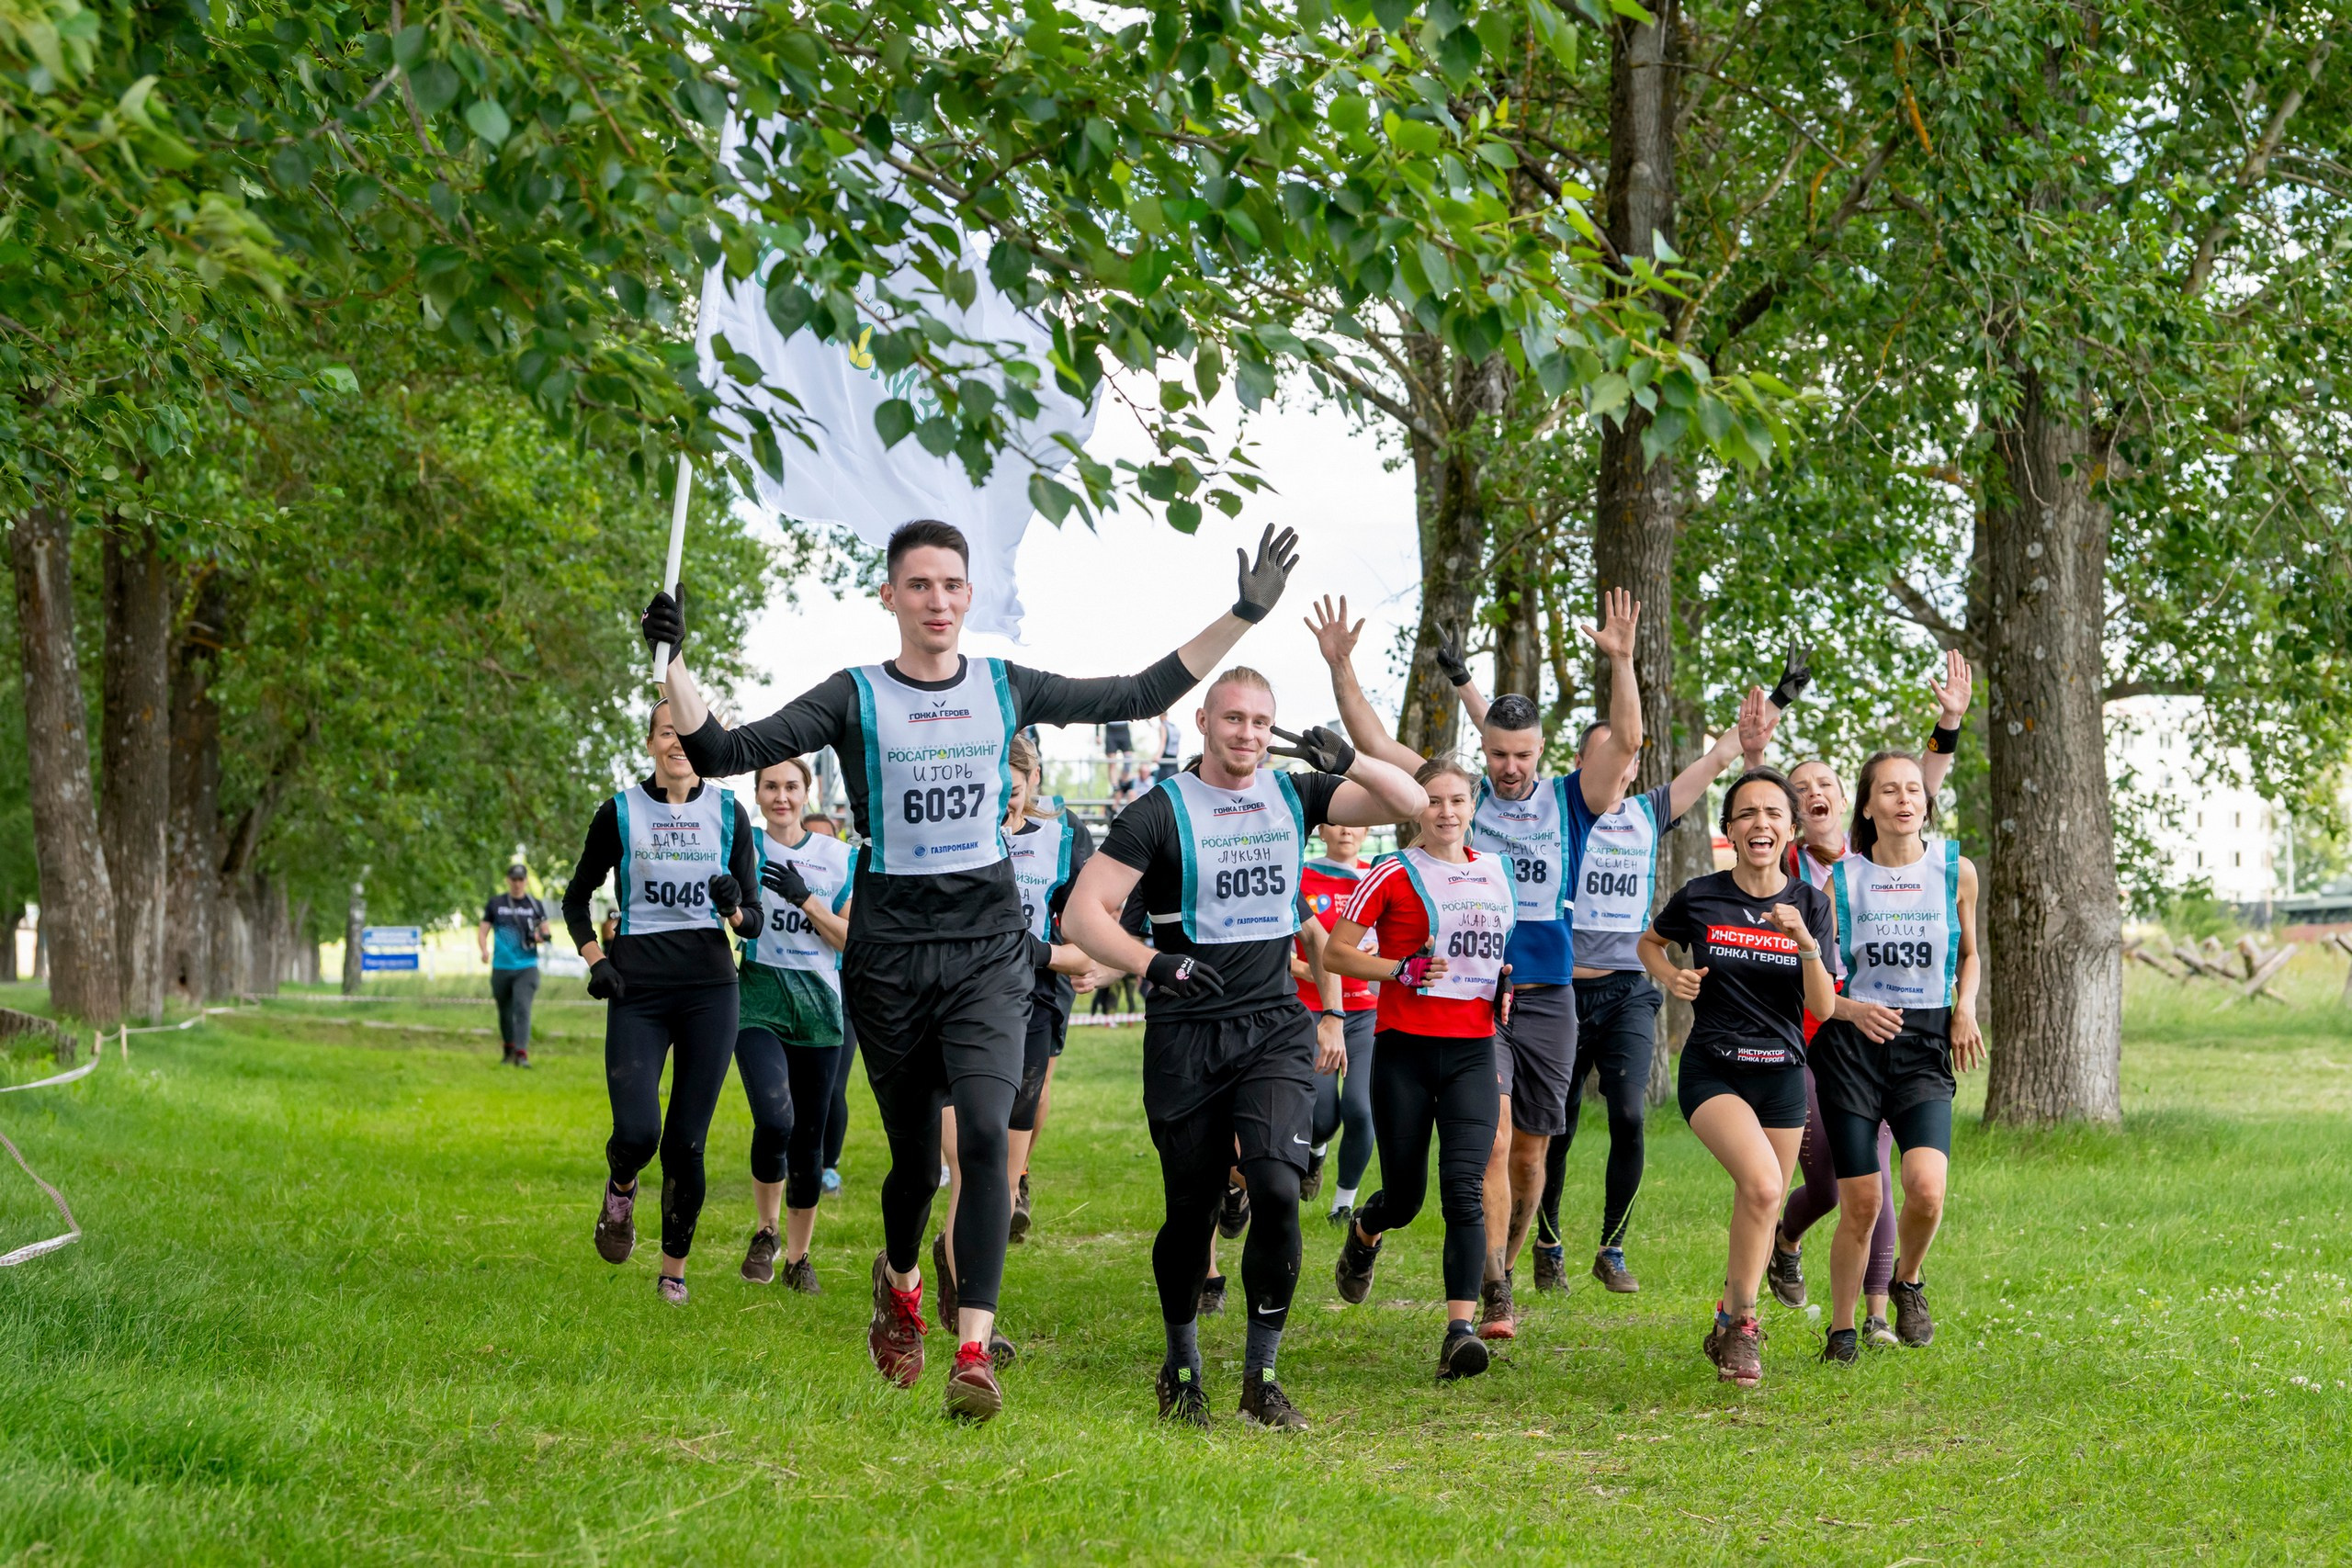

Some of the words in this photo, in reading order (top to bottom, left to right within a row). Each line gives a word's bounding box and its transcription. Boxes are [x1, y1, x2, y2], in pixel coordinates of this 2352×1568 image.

[909, 711, 937, 720] ГОНКА
[940, 708, 970, 717] ГЕРОЕВ
[888, 744, 998, 762] РОСАГРОЛИЗИНГ
[913, 763, 973, 781] ИГОРЬ
[903, 783, 985, 824] 6037
[1238, 802, 1265, 812] ГЕРОЕВ
[651, 831, 700, 847] ДАРЬЯ
[931, 841, 978, 853] ГАЗПРОМБАНК
[1202, 831, 1292, 848] РОСАГРОЛИЗИНГ
[1218, 847, 1271, 863] ЛУКЬЯН
[1499, 841, 1547, 855] ДЕНИС
[635, 851, 718, 862] РОСАГРОЛИЗИНГ
[1510, 857, 1547, 884] 38
[1216, 864, 1285, 899] 6035
[1586, 871, 1637, 897] 6040
[644, 880, 706, 908] 5046
[771, 908, 821, 936] 504
[1237, 916, 1278, 925] ГАЗПРОМБАНК
[1459, 913, 1501, 928] МАРИЯ
[1857, 912, 1941, 924] РОСАГРОЛИЗИНГ
[1875, 924, 1926, 937] ЮЛИЯ
[1448, 931, 1504, 960] 6039
[1711, 930, 1798, 951] ИНСТРУКТОР
[1709, 945, 1749, 959] ГОНКА
[1753, 952, 1797, 966] ГЕРОЕВ
[1865, 942, 1932, 968] 5039
[1464, 977, 1497, 986] ГАЗПРОМБАН
[1885, 984, 1924, 993] ГАЗПРОМБАНК
[1737, 1048, 1785, 1056] ИНСТРУКТОР
